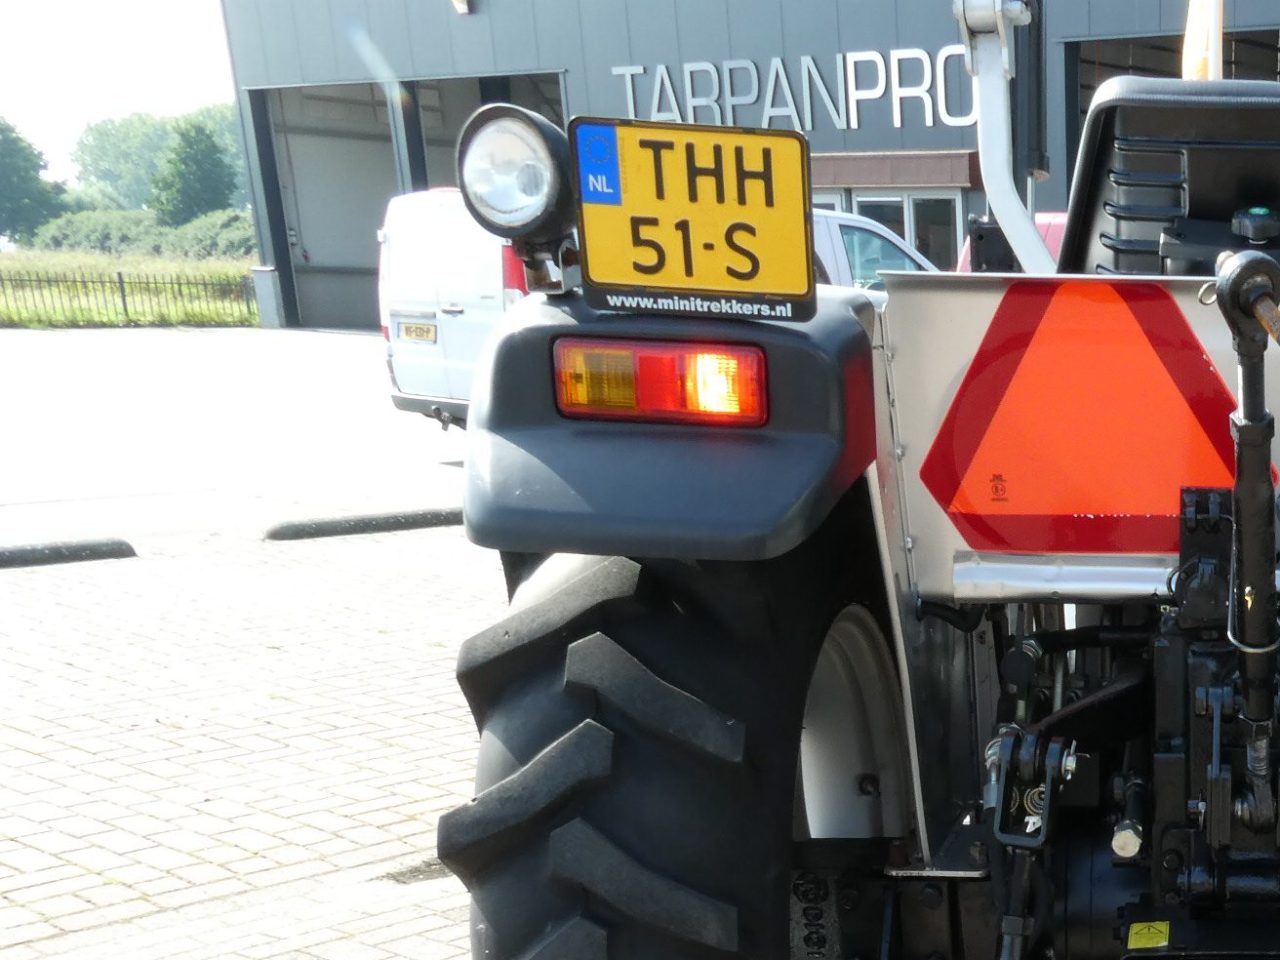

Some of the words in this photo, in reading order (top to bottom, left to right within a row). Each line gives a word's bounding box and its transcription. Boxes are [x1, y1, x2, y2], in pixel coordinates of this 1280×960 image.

[611, 44, 979, 131] TARPANPRO
[588, 174, 614, 194] NL
[638, 139, 775, 208] THH
[629, 216, 761, 281] 51-S
[607, 294, 792, 318] www.minitrekkers.nl
